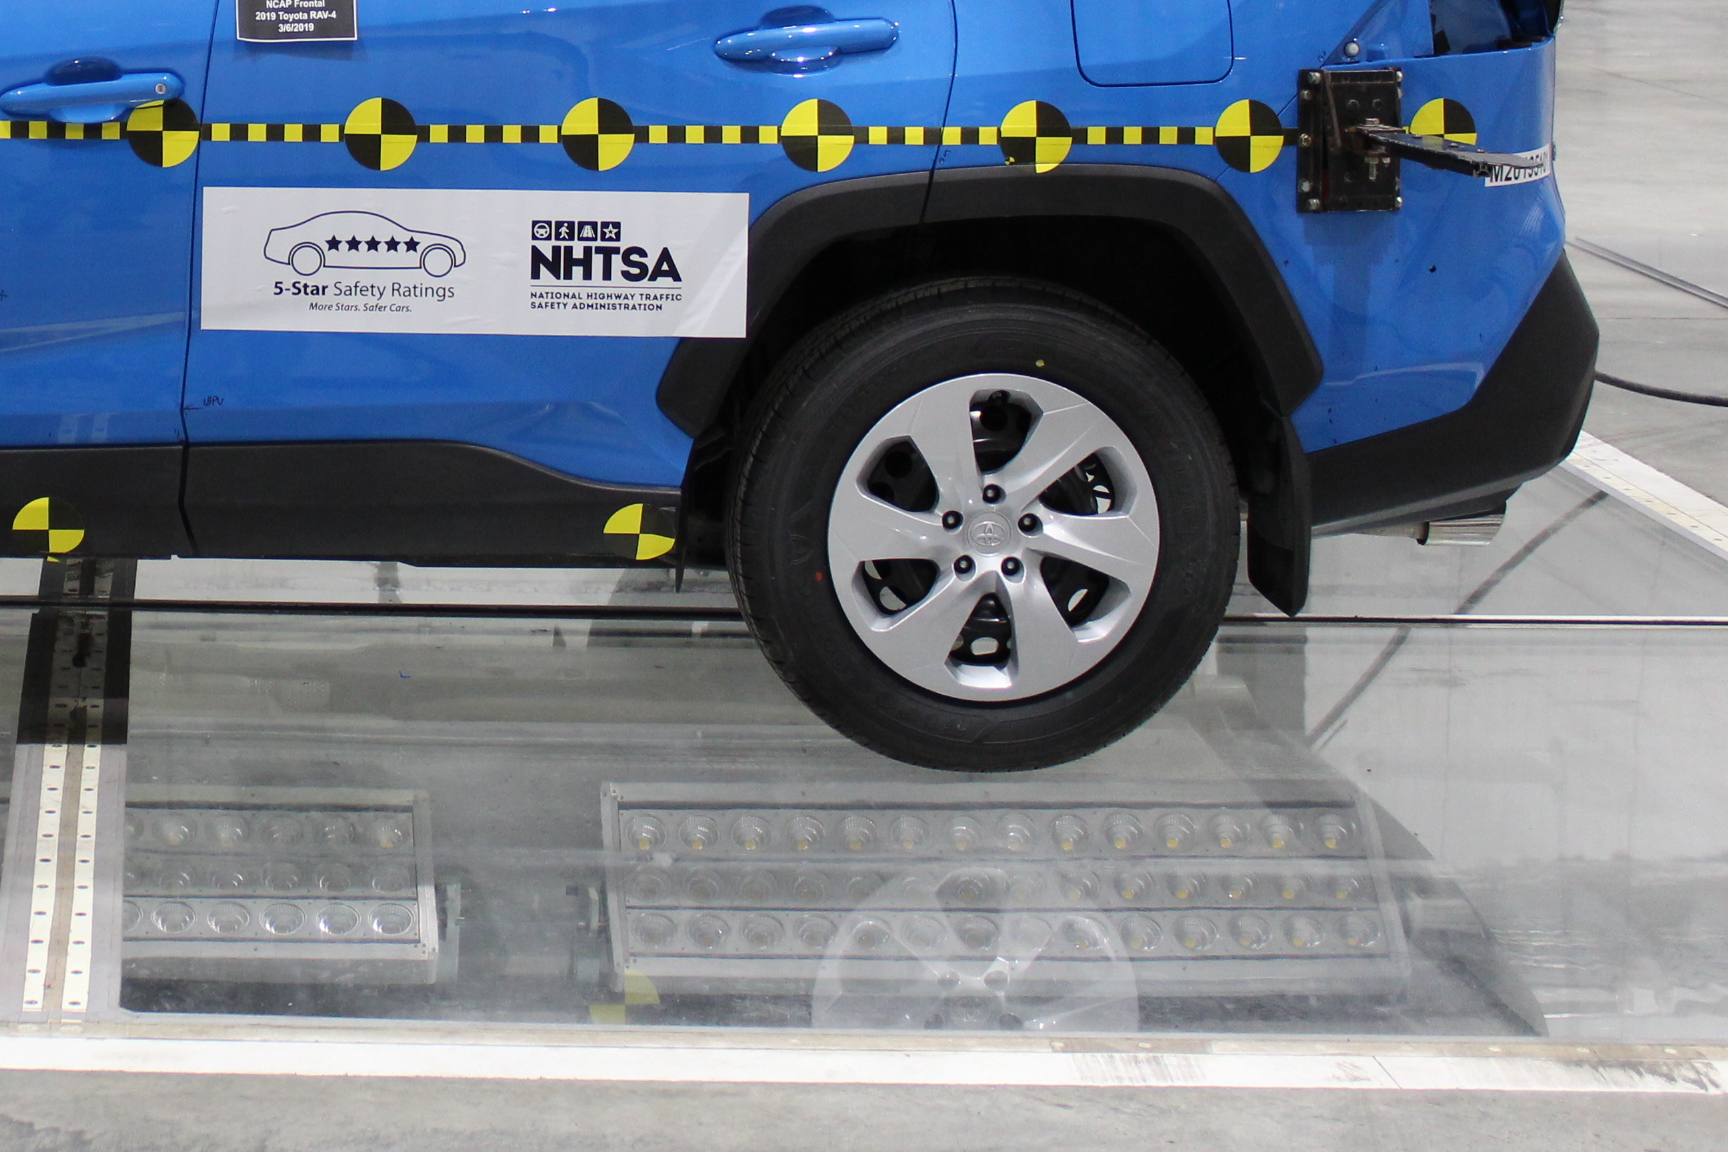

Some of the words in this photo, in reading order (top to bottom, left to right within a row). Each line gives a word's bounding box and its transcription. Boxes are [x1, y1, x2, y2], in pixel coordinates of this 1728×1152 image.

[266, 0, 292, 9] NCAP
[294, 0, 326, 8] Frontal
[255, 11, 276, 21] 2019
[278, 11, 308, 22] Toyota
[309, 10, 337, 20] RAV-4
[278, 23, 314, 33] 3/6/2019
[530, 244, 682, 282] NHTSA
[273, 281, 328, 296] 5-Star
[334, 281, 386, 300] Safety
[392, 282, 455, 302] Ratings
[530, 292, 583, 300] NATIONAL
[587, 292, 635, 301] HIGHWAY
[639, 293, 682, 301] TRAFFIC
[309, 302, 333, 311] More
[335, 303, 360, 312] Stars.
[363, 303, 388, 312] Safer
[390, 304, 412, 312] Cars.
[530, 301, 568, 309] SAFETY
[572, 303, 663, 311] ADMINISTRATION
